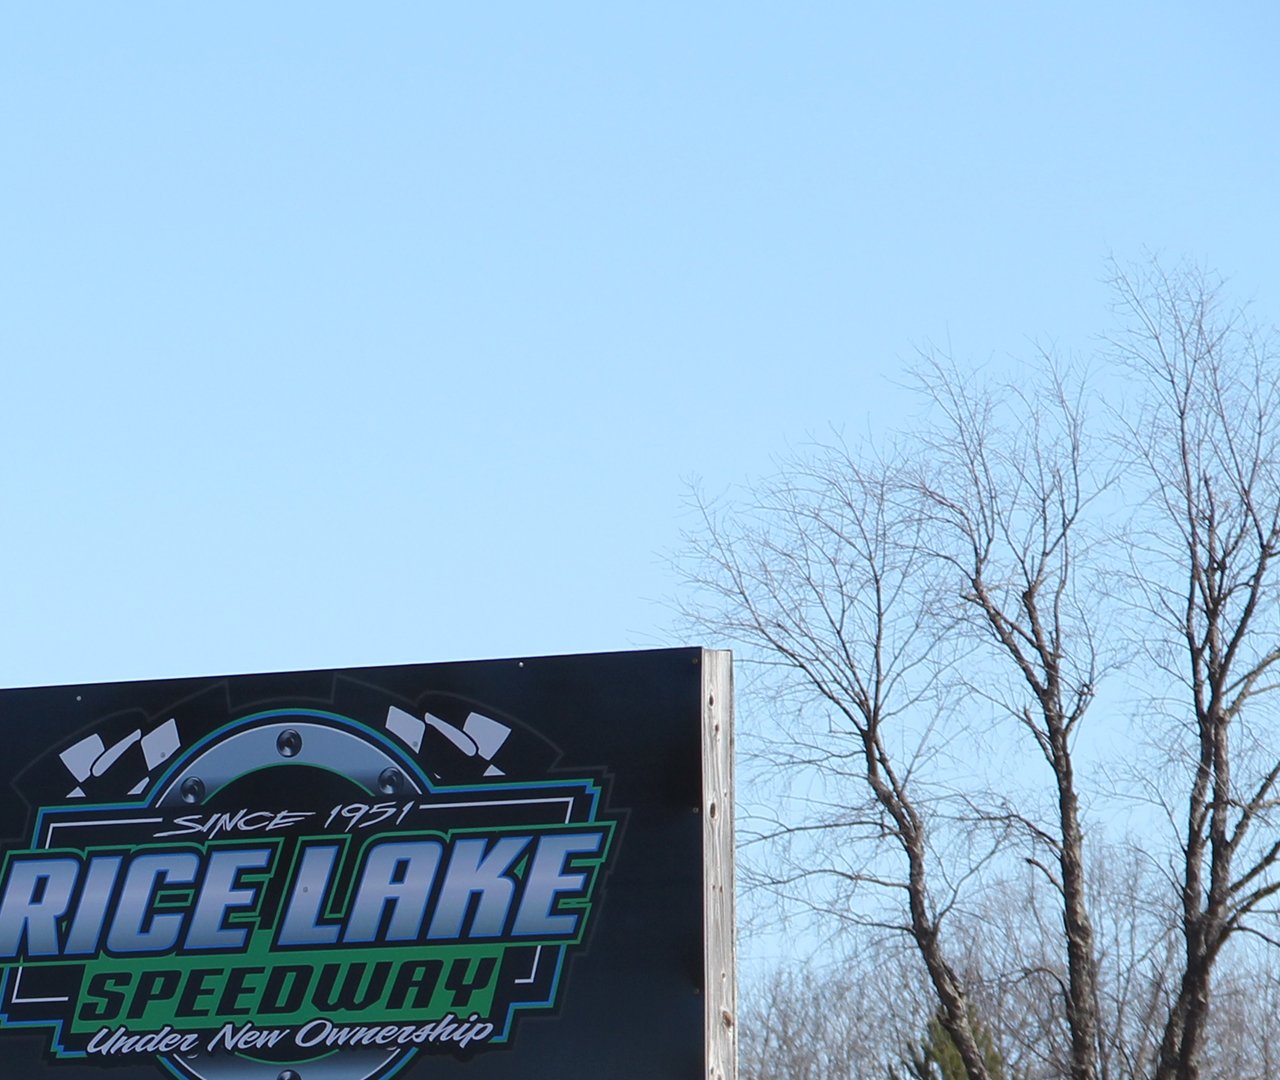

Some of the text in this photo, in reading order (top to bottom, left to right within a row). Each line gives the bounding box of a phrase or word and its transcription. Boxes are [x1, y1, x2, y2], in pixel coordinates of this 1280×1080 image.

[153, 801, 415, 839] SINCE 1951
[277, 832, 604, 946] LAKE
[78, 957, 498, 1022] SPEEDWAY
[86, 1014, 494, 1056] Under New Ownership
